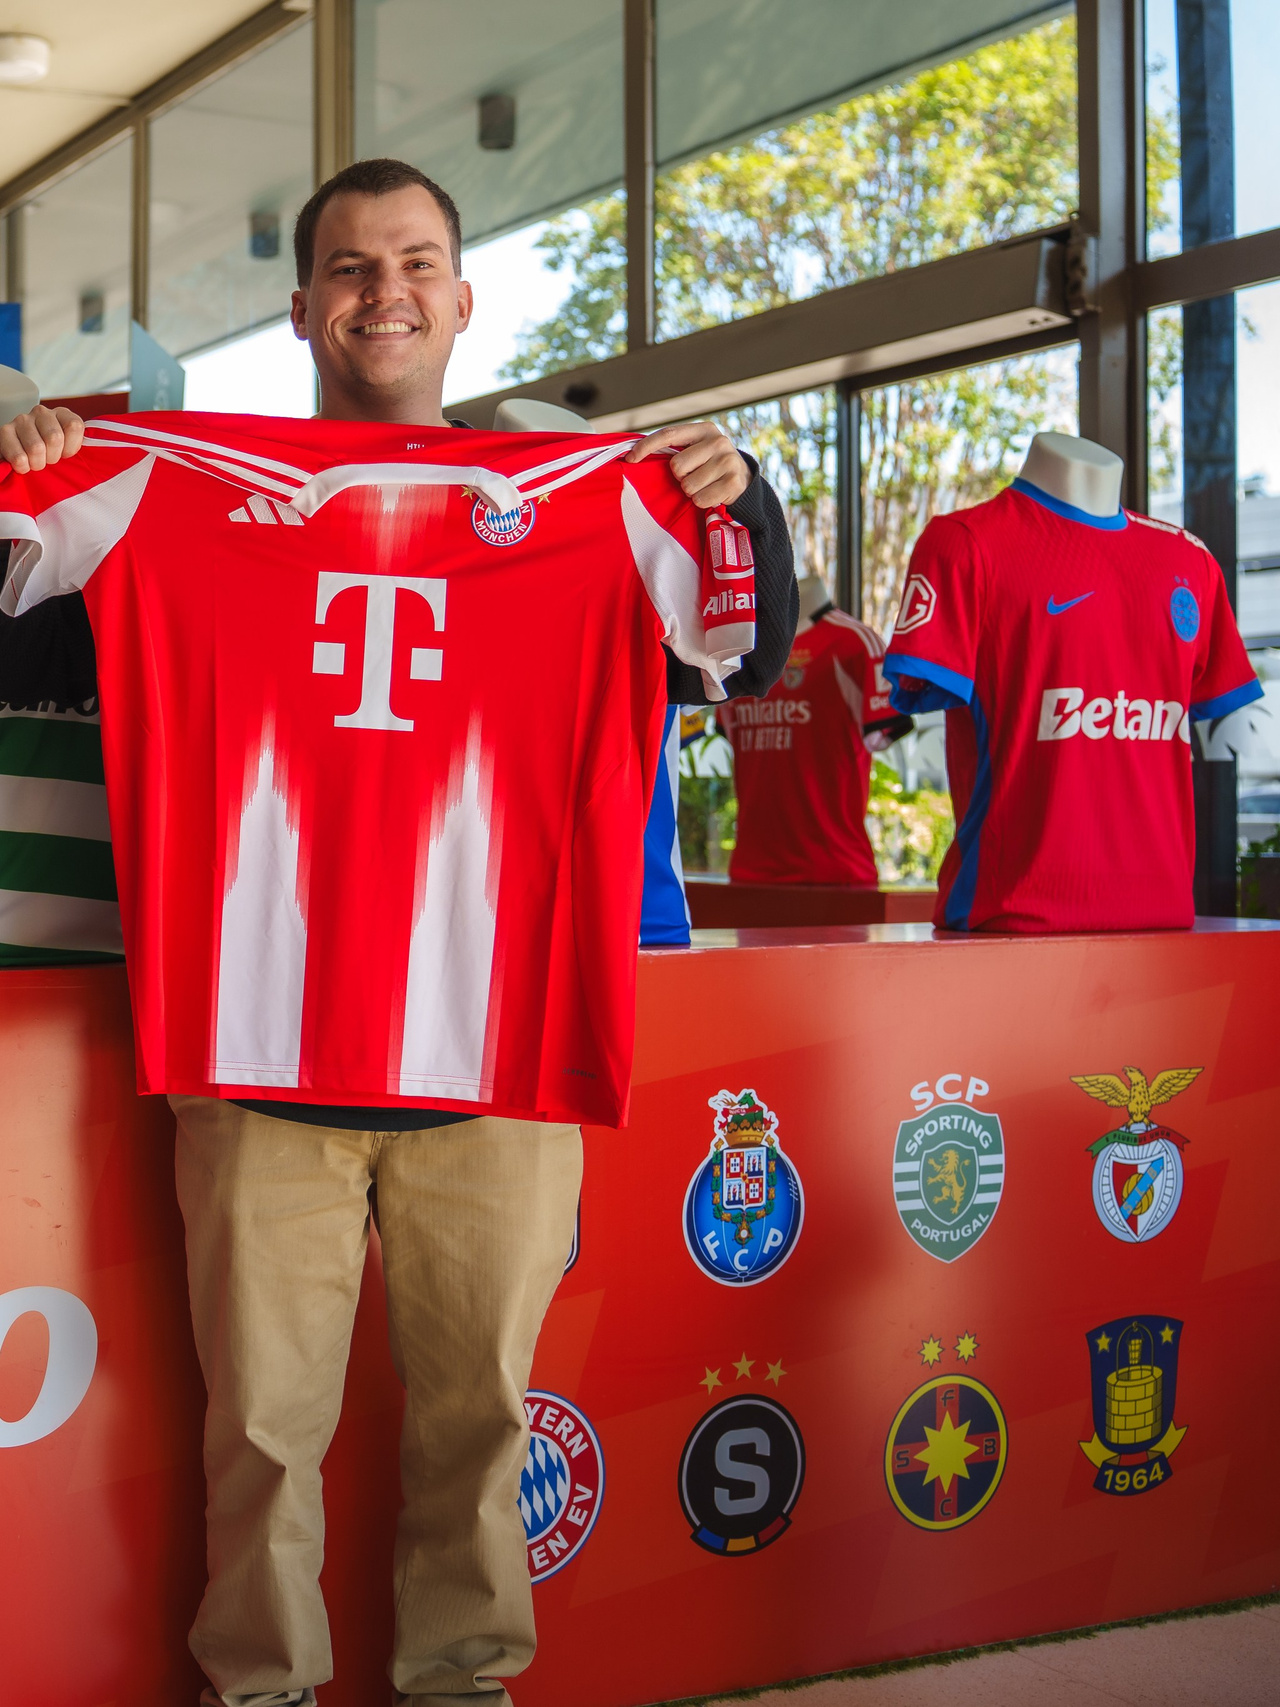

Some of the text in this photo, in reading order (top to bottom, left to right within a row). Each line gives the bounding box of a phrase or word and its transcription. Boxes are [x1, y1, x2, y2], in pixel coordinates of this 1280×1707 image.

[476, 520, 527, 543] MÜNCHEN
[910, 1073, 990, 1112] SCP
[905, 1114, 993, 1157] SPORTING
[910, 1212, 990, 1243] PORTUGAL
[524, 1402, 589, 1459] YERN
[714, 1426, 771, 1517] S
[1104, 1461, 1165, 1492] 1964
